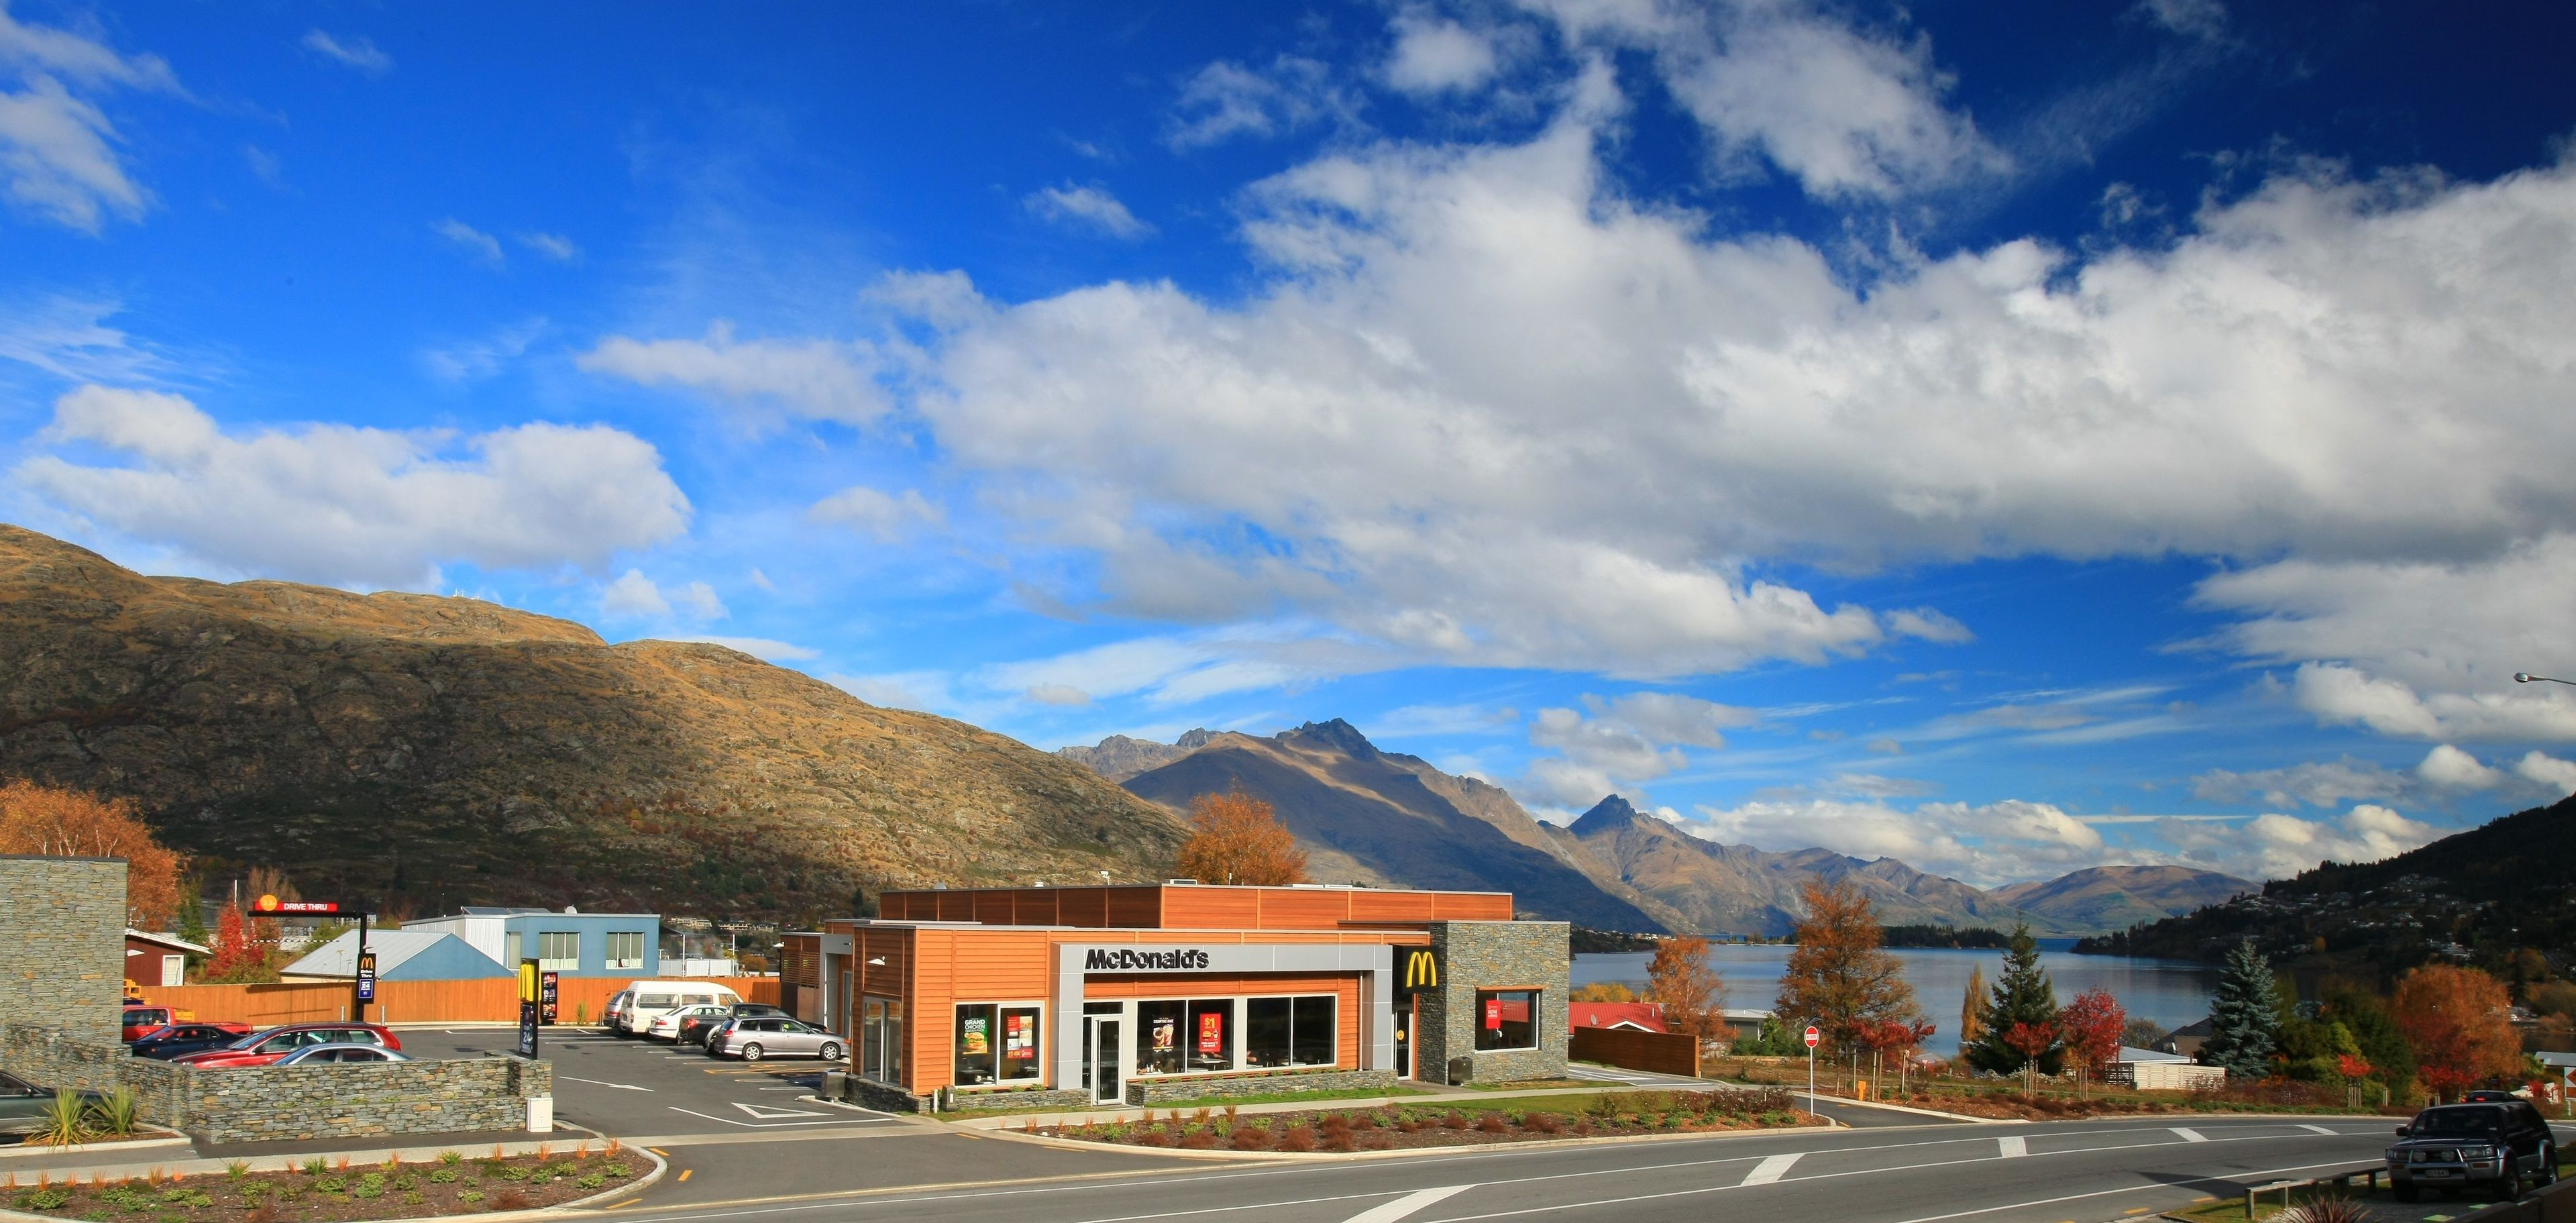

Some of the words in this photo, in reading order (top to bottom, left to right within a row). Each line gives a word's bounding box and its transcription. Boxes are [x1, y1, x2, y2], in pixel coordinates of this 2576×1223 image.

[1085, 949, 1208, 969] McDonald's
[1204, 1017, 1215, 1028] $1
[523, 1032, 530, 1043] 24
